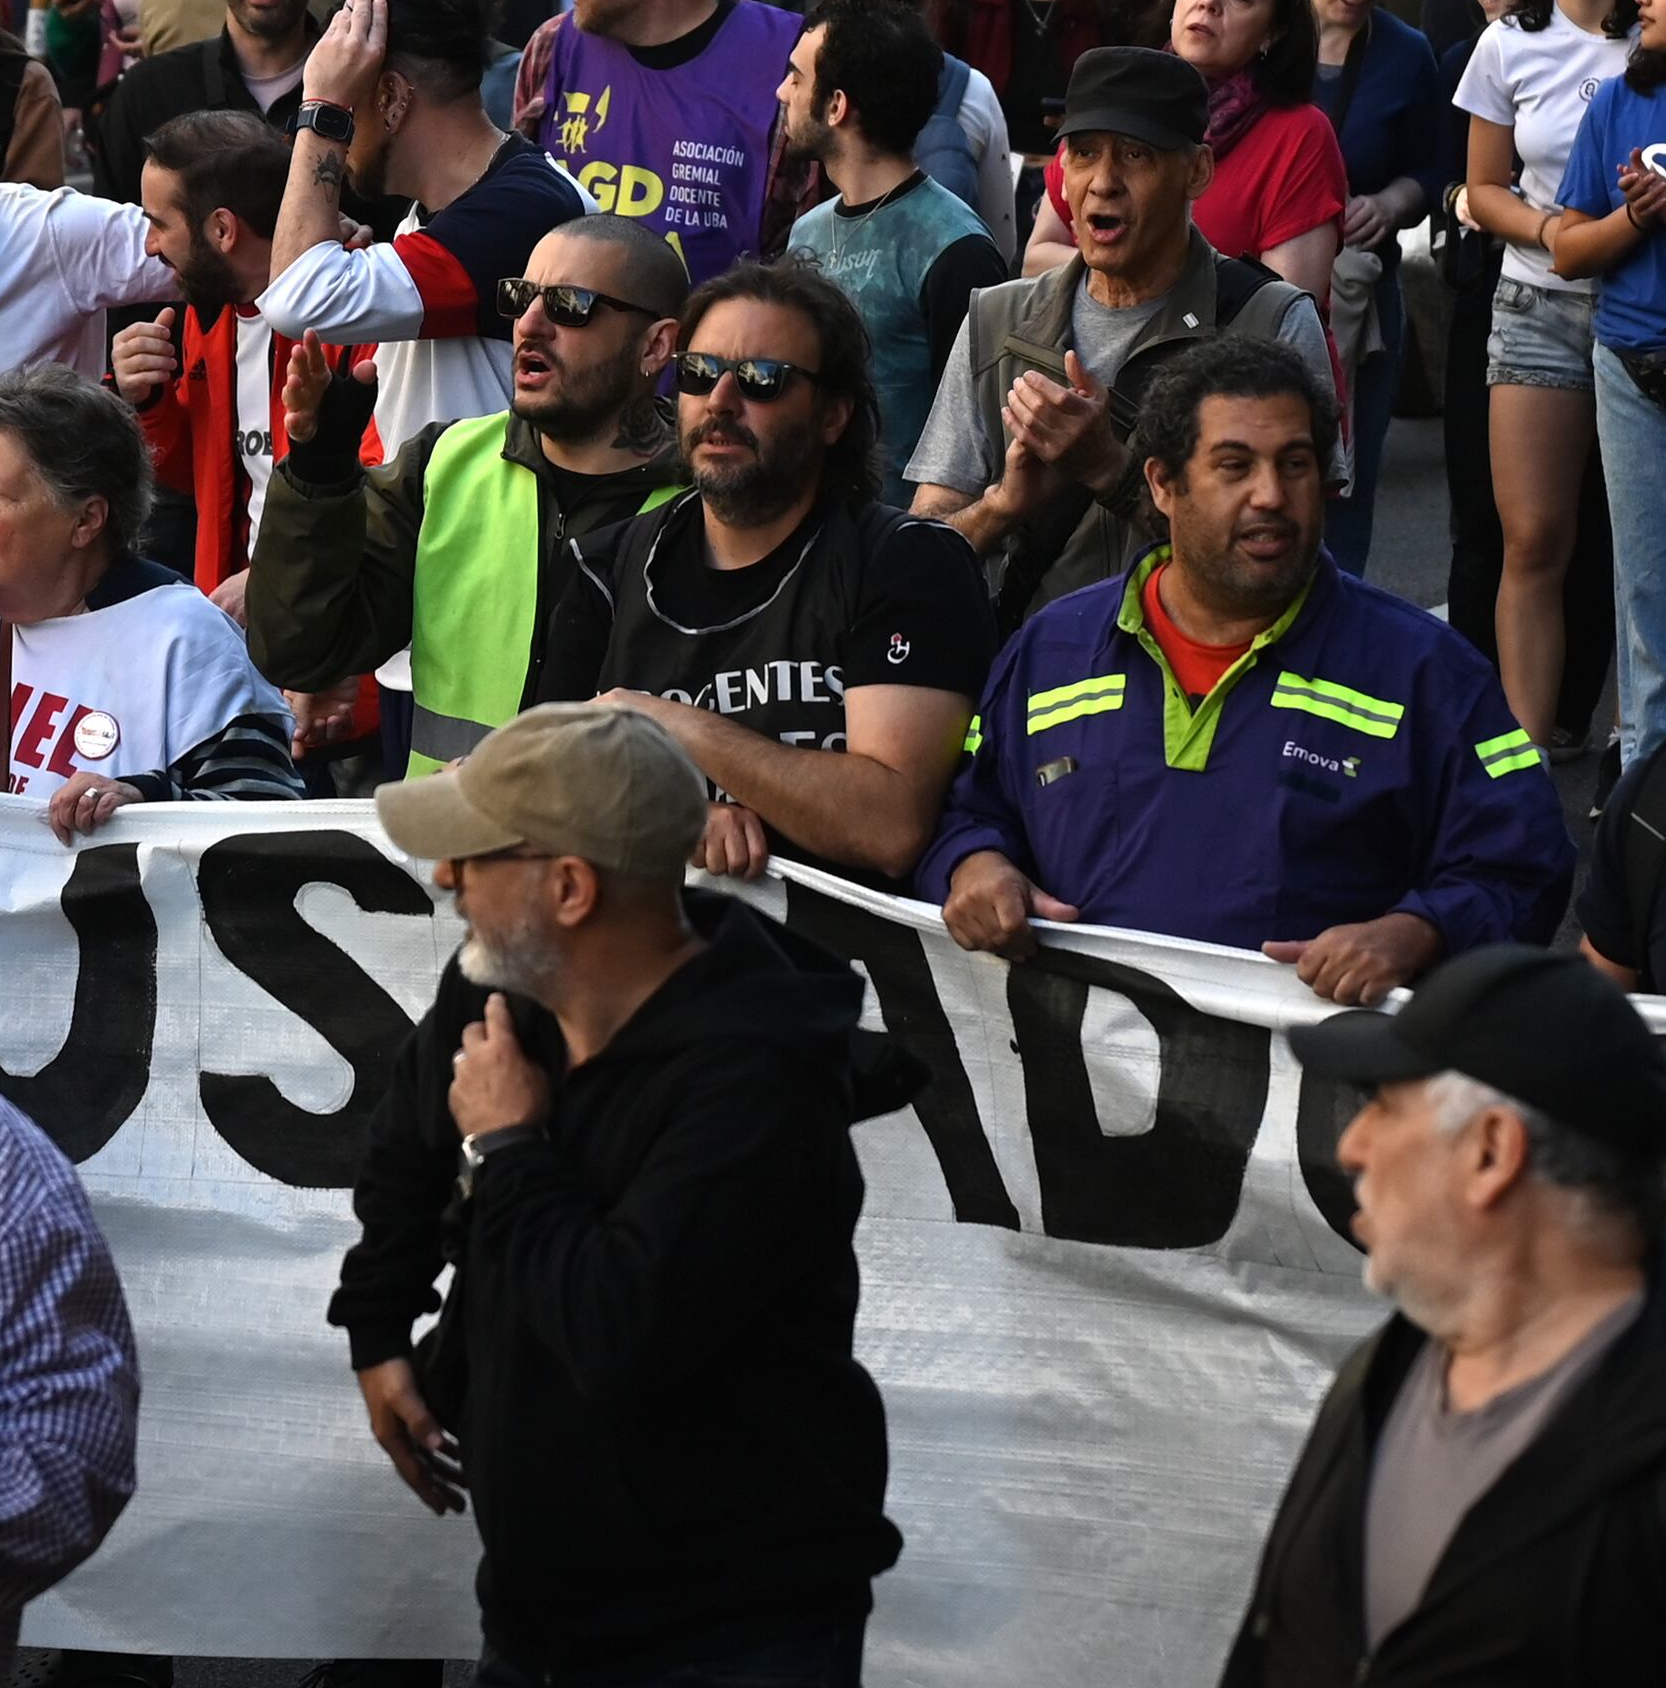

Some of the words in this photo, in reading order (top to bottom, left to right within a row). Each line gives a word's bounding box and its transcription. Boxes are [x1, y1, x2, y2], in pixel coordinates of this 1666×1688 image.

[672, 140, 745, 167] ASOCIACIÓN
[671, 163, 721, 186] GREMIAL
[555, 160, 664, 217] GD
[669, 186, 721, 207] DOCENTE
[664, 207, 682, 223] DE
[685, 210, 701, 227] LA
[704, 211, 728, 229] UBA
[1282, 741, 1339, 772] Emova
